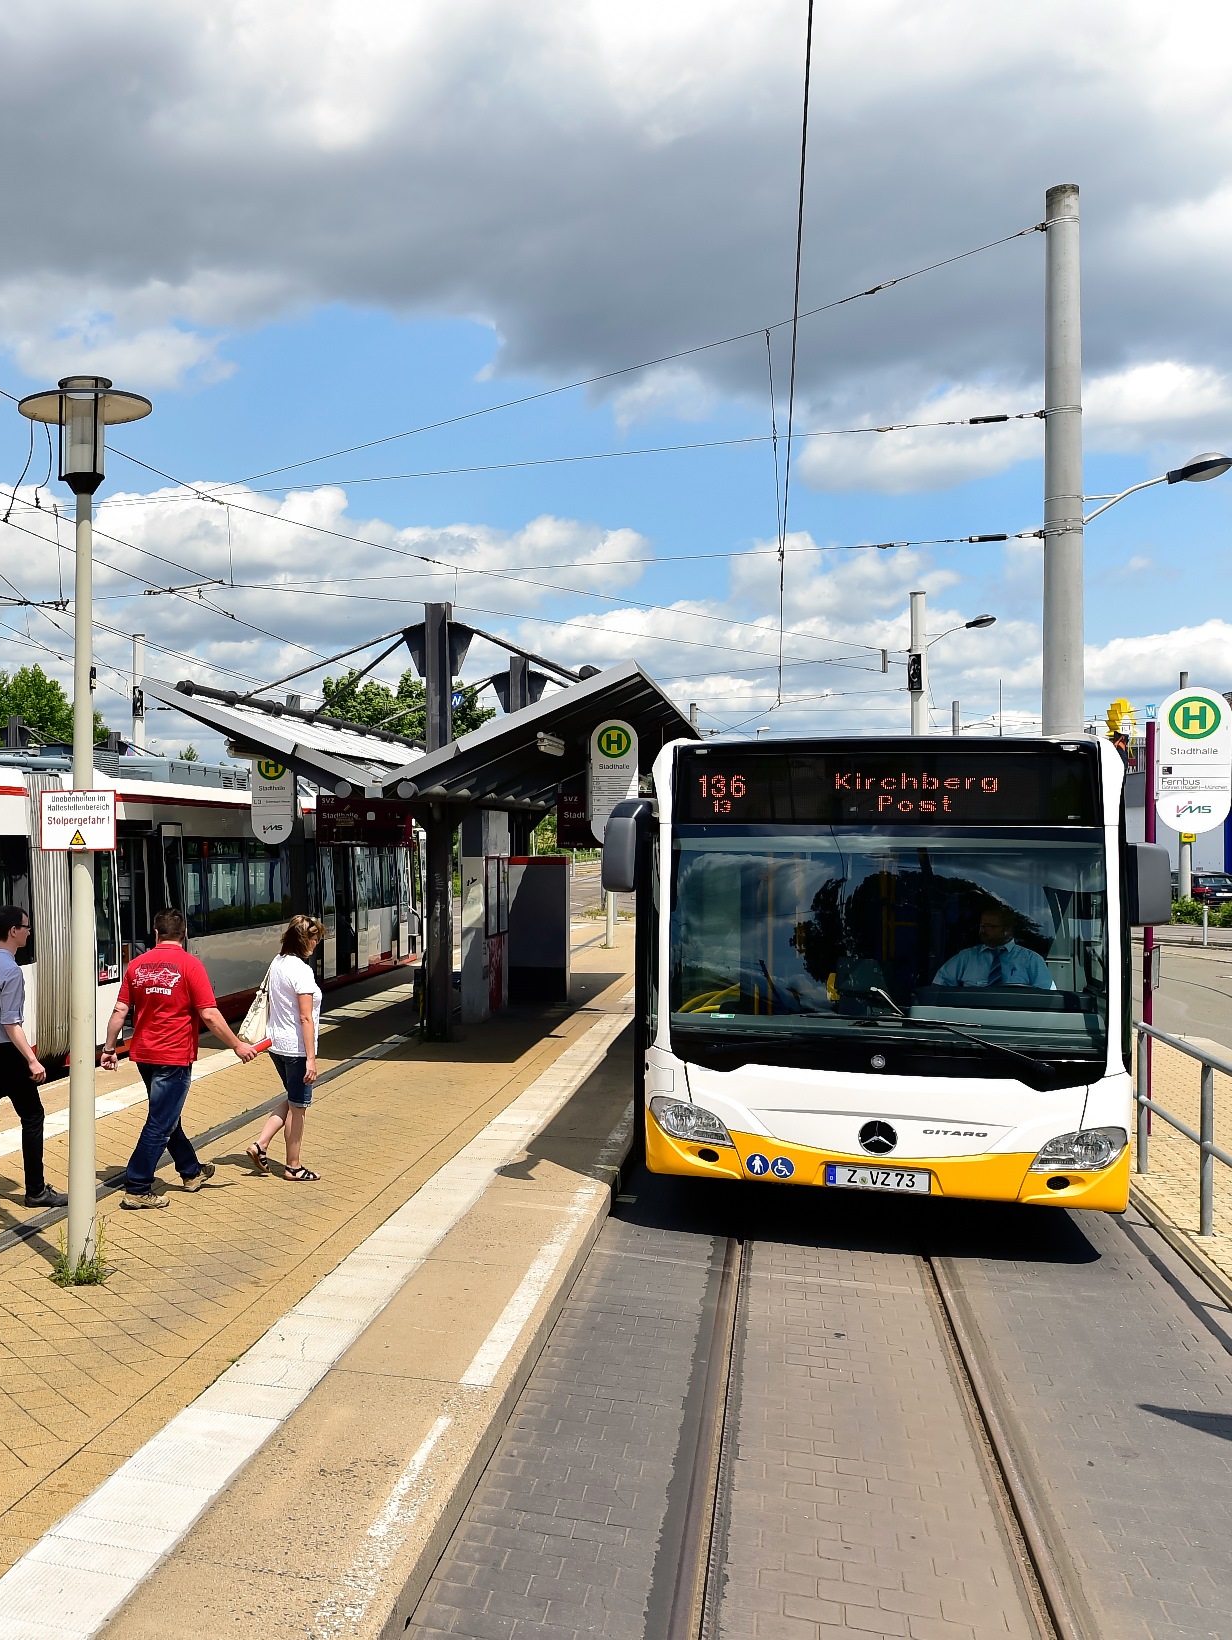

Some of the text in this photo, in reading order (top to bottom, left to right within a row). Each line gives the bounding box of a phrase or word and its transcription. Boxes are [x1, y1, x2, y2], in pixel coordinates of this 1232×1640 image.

[1170, 747, 1219, 755] Stadthalle
[698, 774, 747, 798] 136
[835, 772, 999, 793] Kirchberg
[1161, 777, 1201, 786] Fernbus
[51, 795, 96, 803] Unebenheiten
[878, 795, 952, 812] Post
[712, 799, 732, 813] 13
[47, 816, 106, 827] Stolpergefahr
[922, 1129, 988, 1138] CITARO
[847, 1169, 858, 1184] Z
